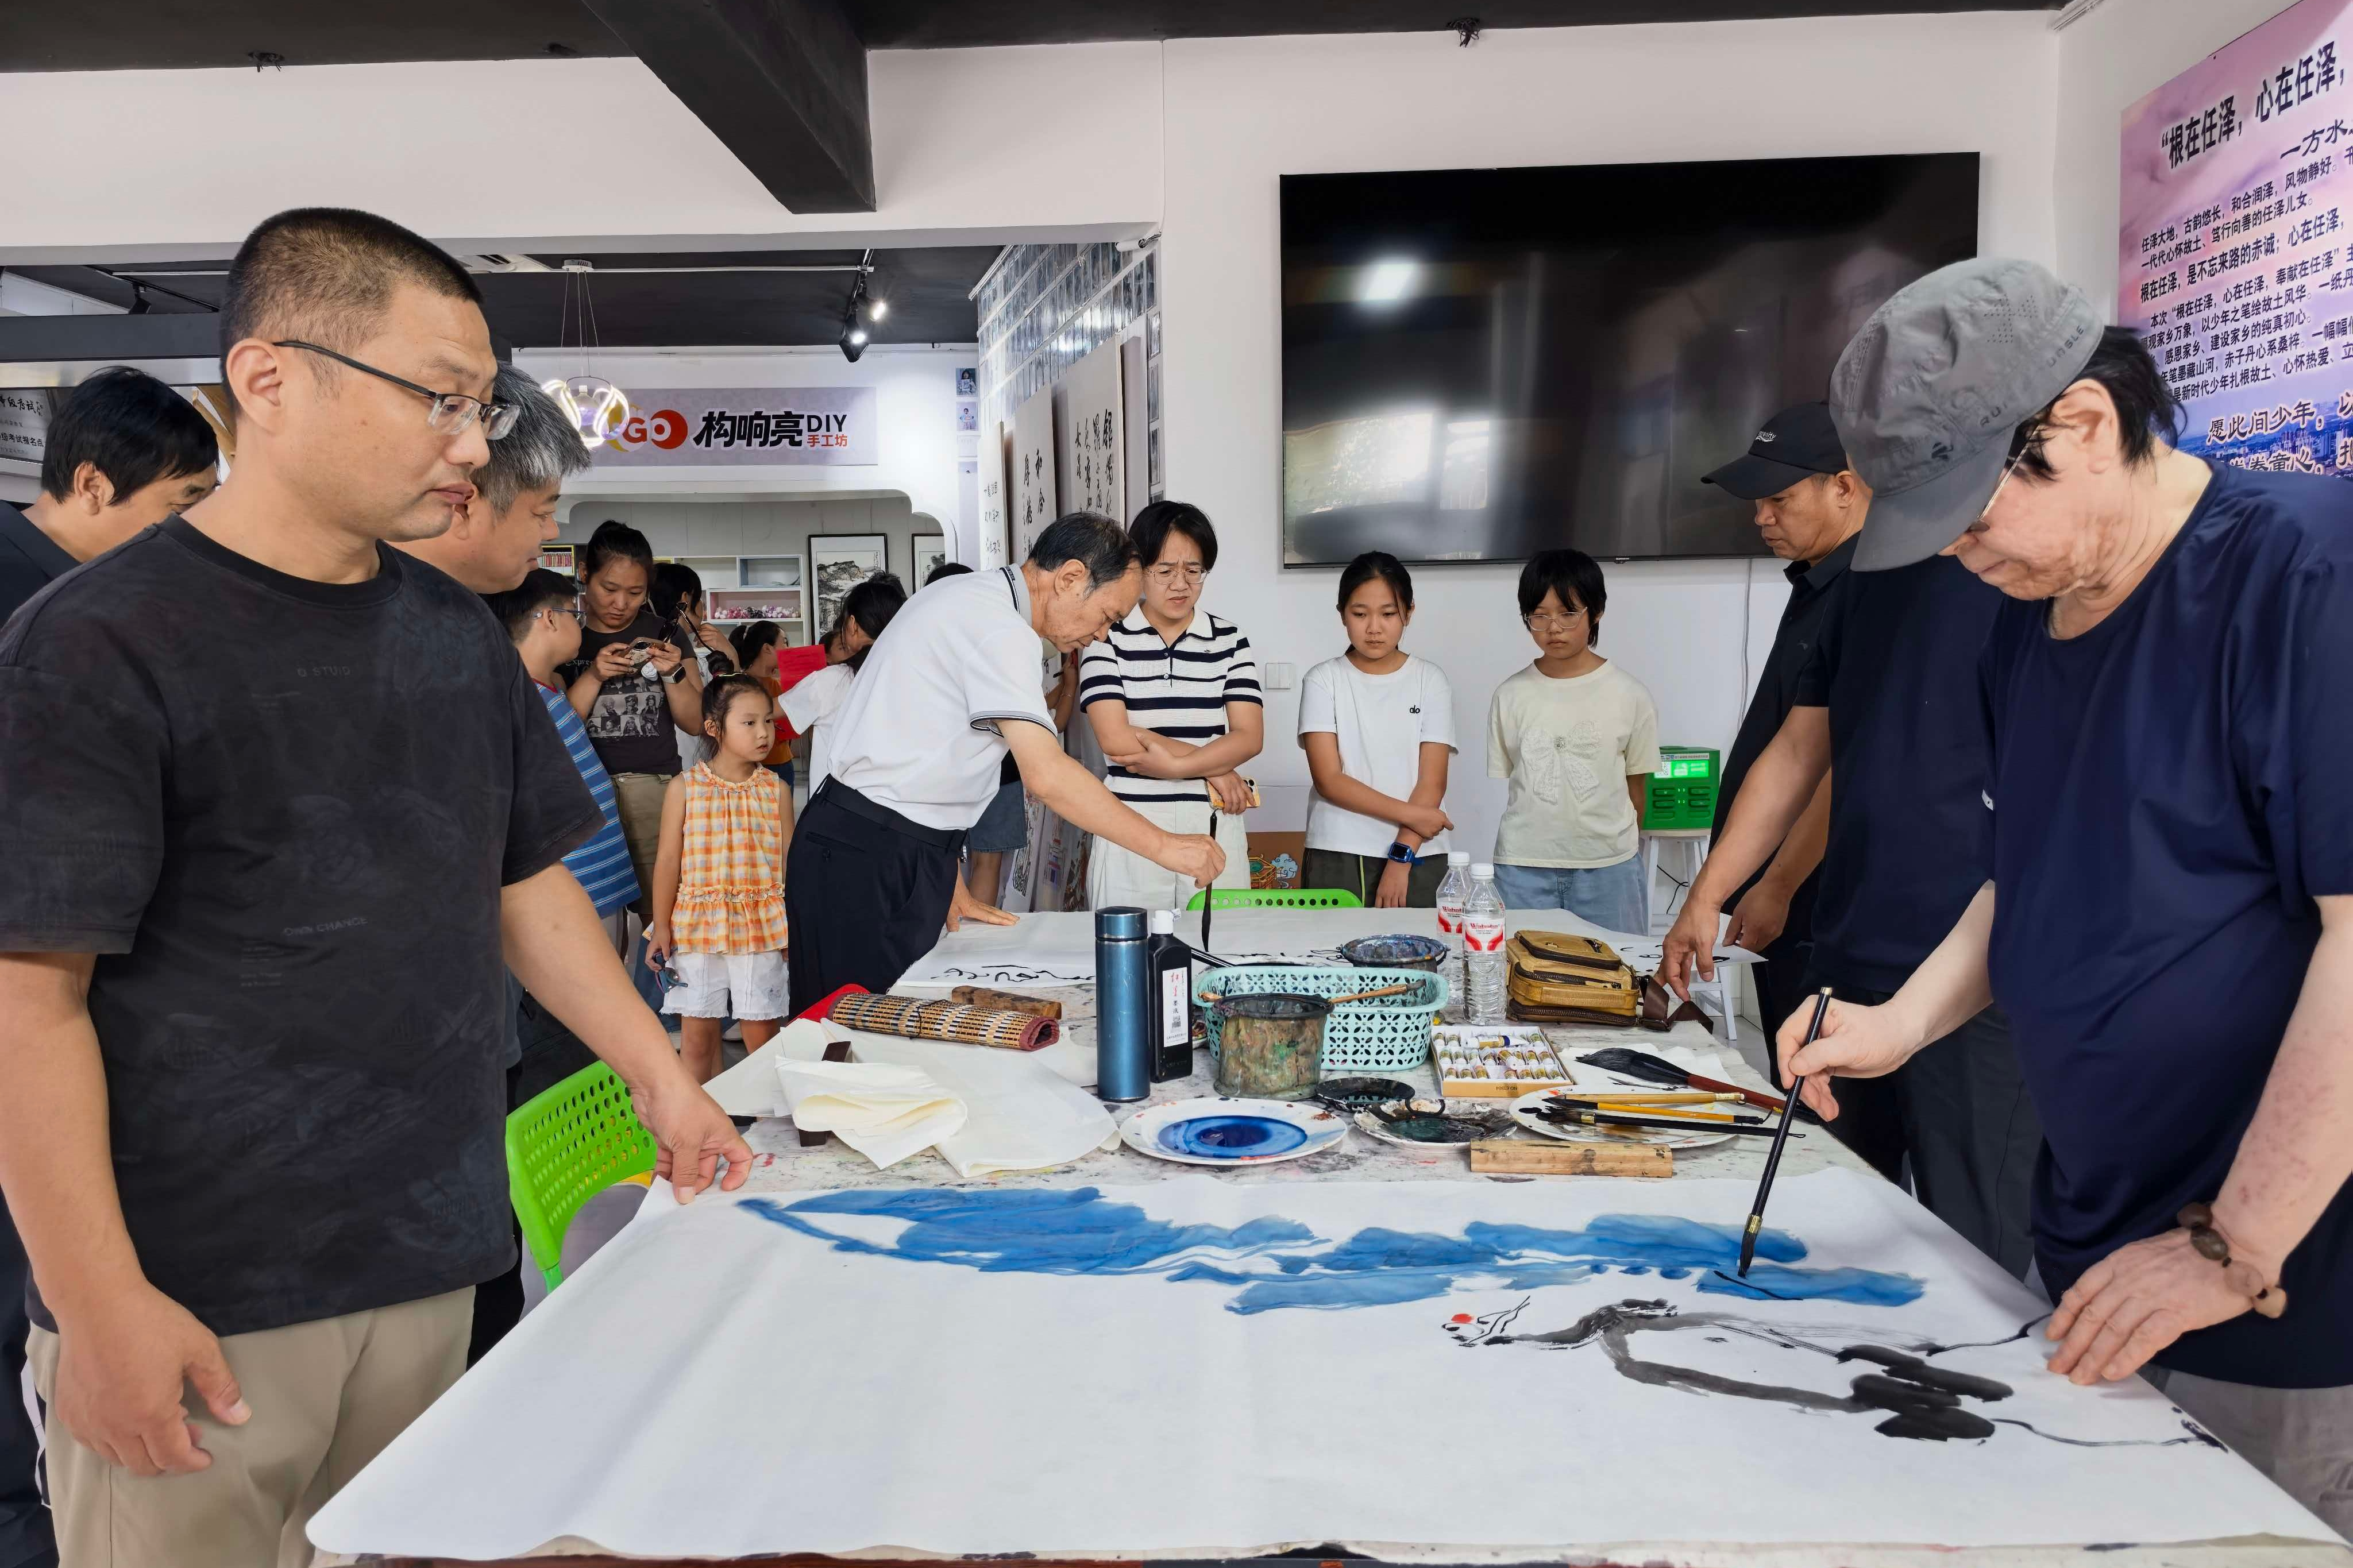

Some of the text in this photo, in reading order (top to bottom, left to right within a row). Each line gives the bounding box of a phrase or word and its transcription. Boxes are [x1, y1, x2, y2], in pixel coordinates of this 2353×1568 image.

[2280, 119, 2353, 159] 一方水
[807, 434, 847, 447] 手工坊
[1409, 705, 1420, 713] alo
